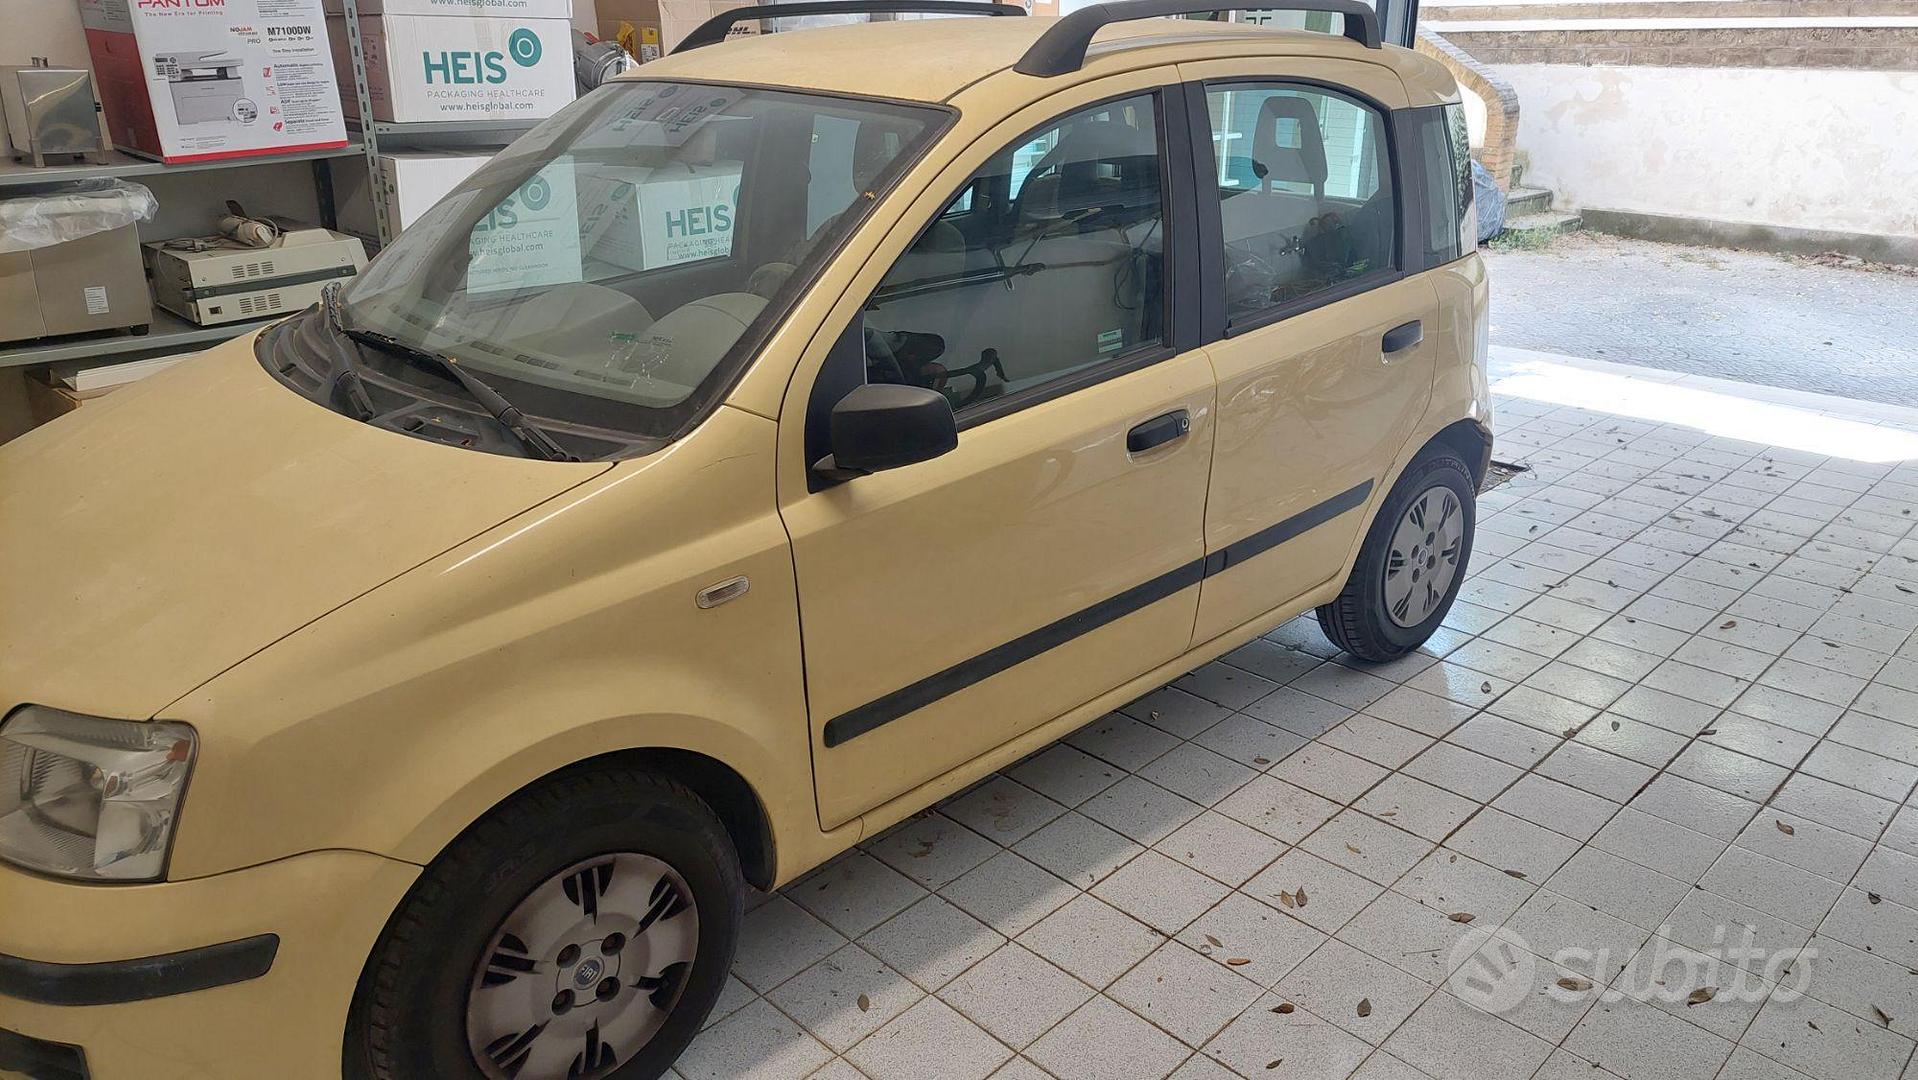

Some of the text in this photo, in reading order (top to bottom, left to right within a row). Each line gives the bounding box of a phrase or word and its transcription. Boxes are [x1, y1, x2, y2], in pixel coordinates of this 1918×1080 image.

[431, 0, 527, 8] www.heisglobal.com
[267, 26, 312, 36] M7100DW
[422, 51, 507, 84] HEIS
[427, 88, 545, 99] PACKAGING HEALTHCARE
[440, 101, 534, 112] www.heisglobal.com
[665, 204, 731, 238] HEIS
[500, 230, 553, 242] HEALTHCARE
